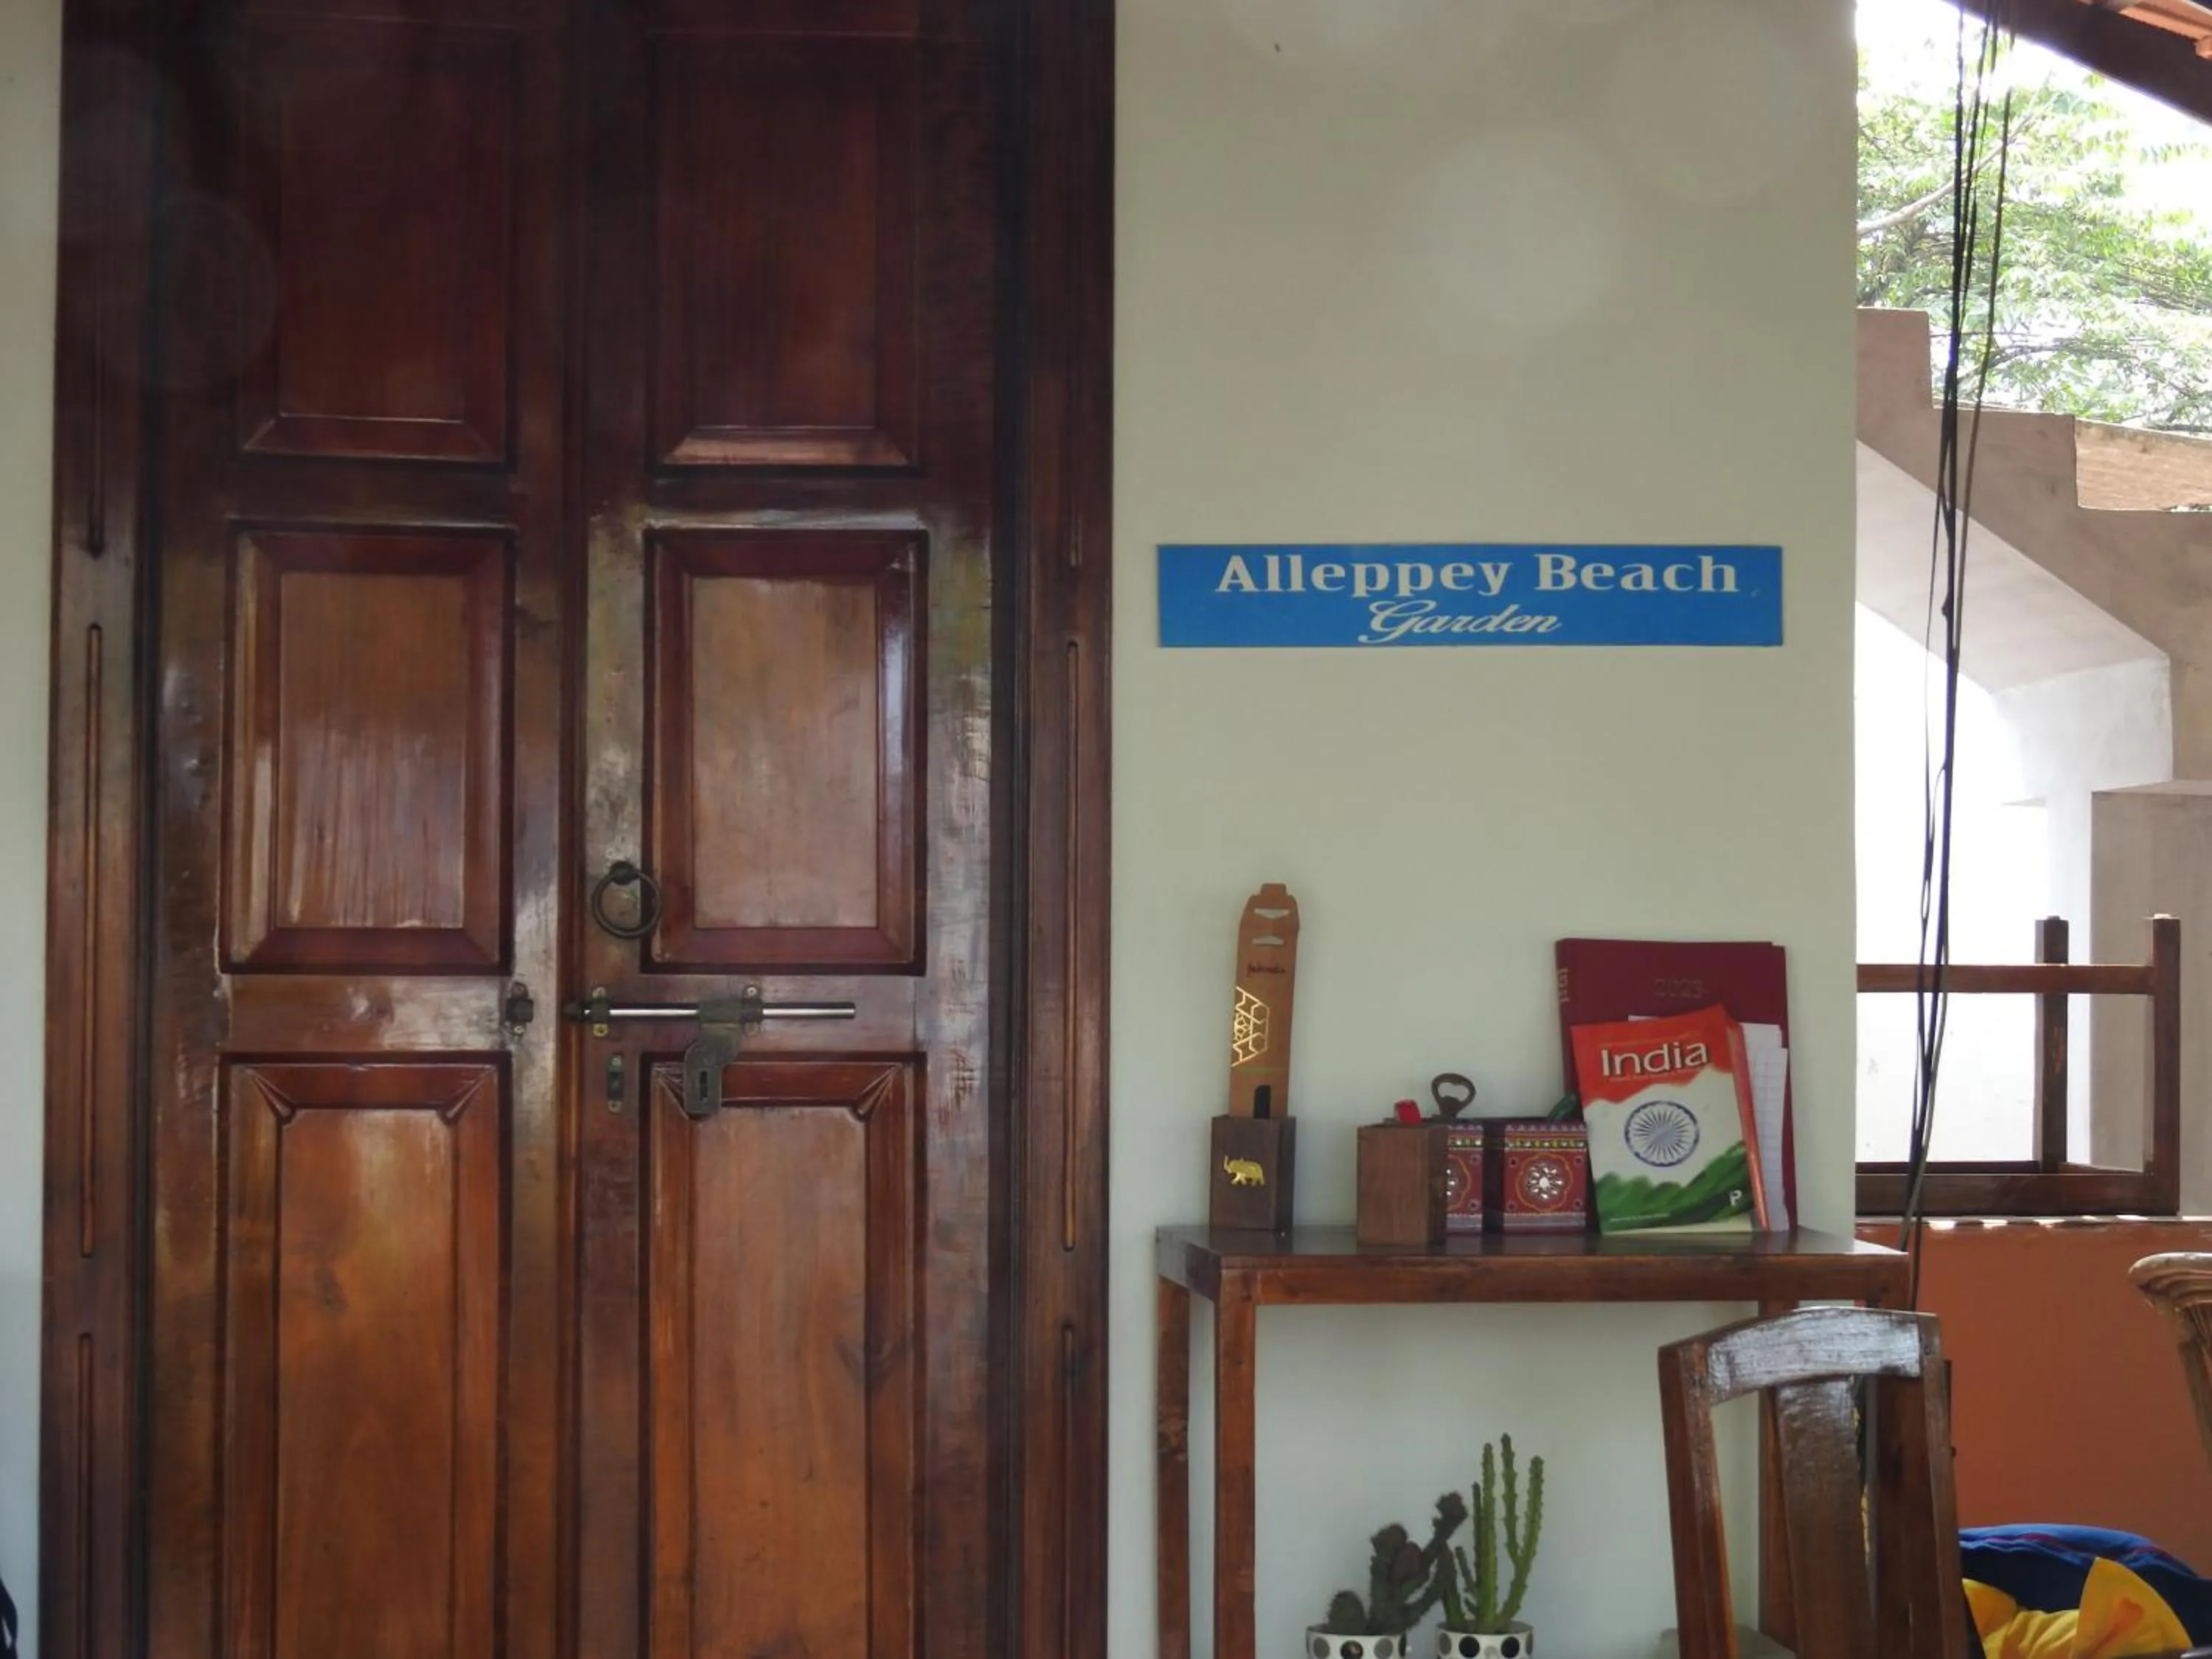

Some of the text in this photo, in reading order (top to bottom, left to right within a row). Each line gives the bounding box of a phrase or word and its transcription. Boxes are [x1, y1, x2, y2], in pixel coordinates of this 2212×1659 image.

[1214, 554, 1740, 598] Alleppey Beach
[1357, 599, 1562, 644] Garden
[1601, 1041, 1708, 1077] India
